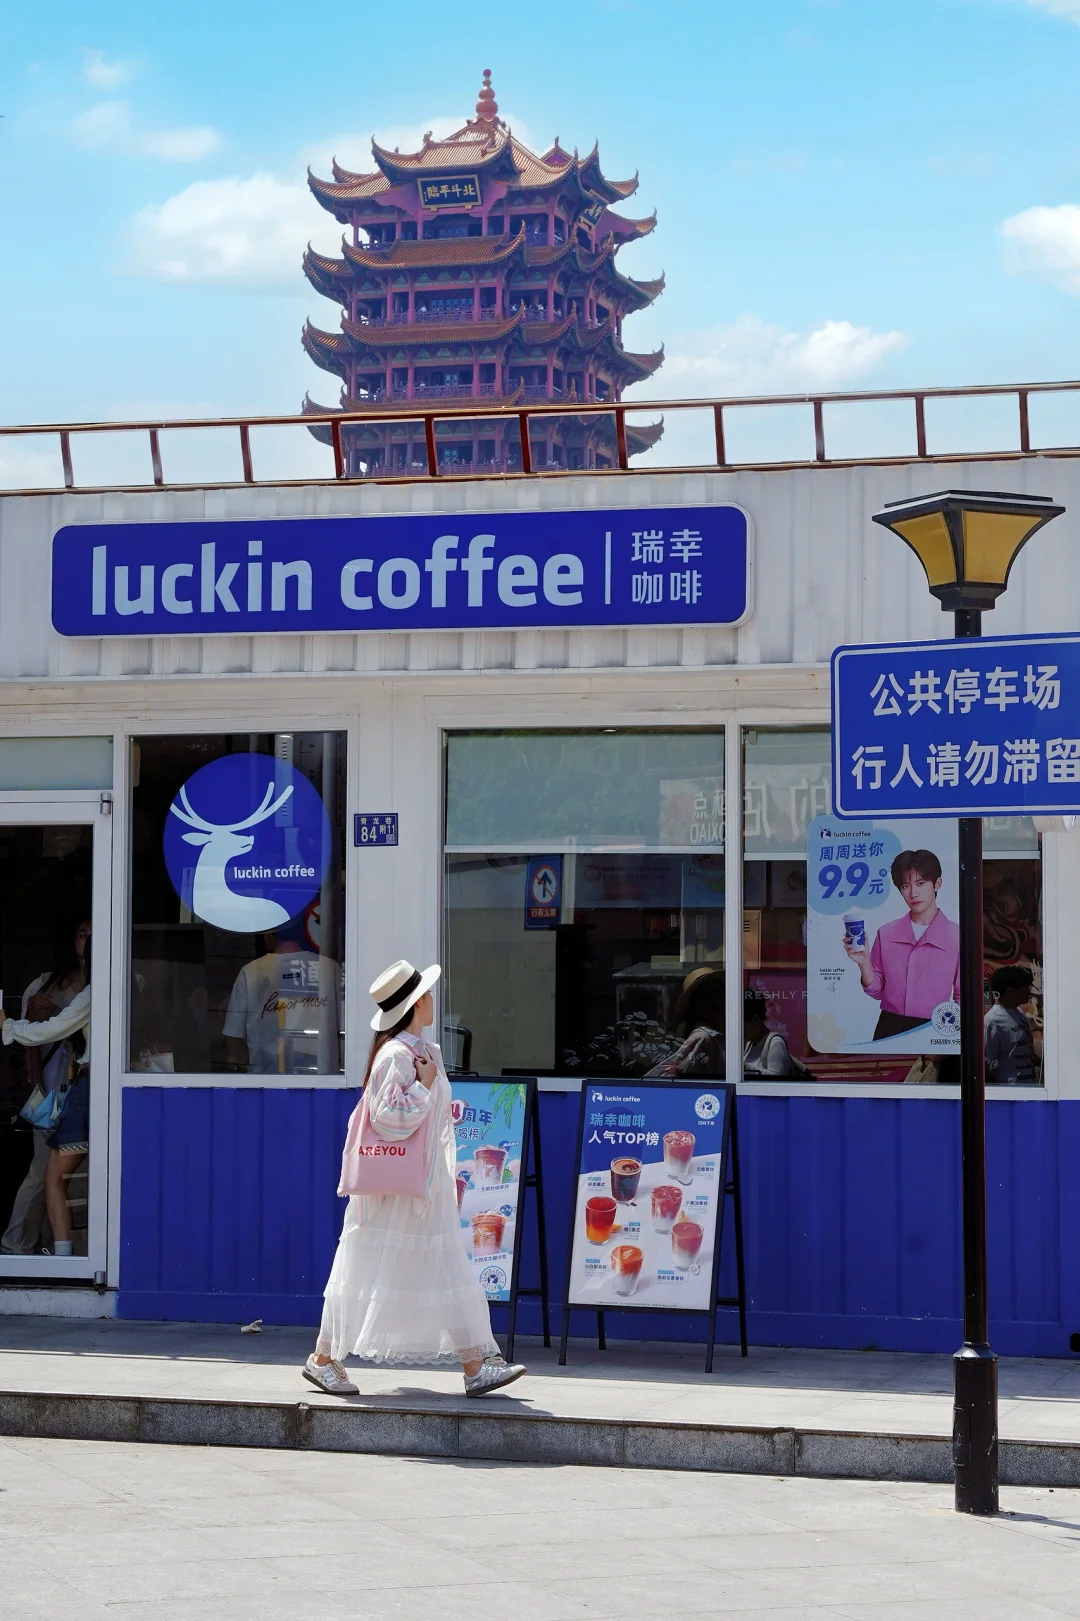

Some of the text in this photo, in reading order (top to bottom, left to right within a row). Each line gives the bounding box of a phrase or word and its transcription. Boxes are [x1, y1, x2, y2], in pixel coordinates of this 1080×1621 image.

[631, 529, 703, 564] 瑞幸
[92, 534, 584, 616] luckin coffee
[631, 570, 703, 604] 咖啡
[869, 664, 1061, 716] 公共停车场
[851, 737, 1080, 790] 行人请勿滞留
[360, 816, 392, 825] 青龙巷
[361, 826, 377, 842] 84
[819, 841, 884, 861] 周周送你
[234, 864, 315, 879] luckin coffee
[744, 990, 797, 999] RESHLY
[590, 1113, 646, 1128] 瑞幸咖啡
[588, 1130, 660, 1146] 人气TOP榜
